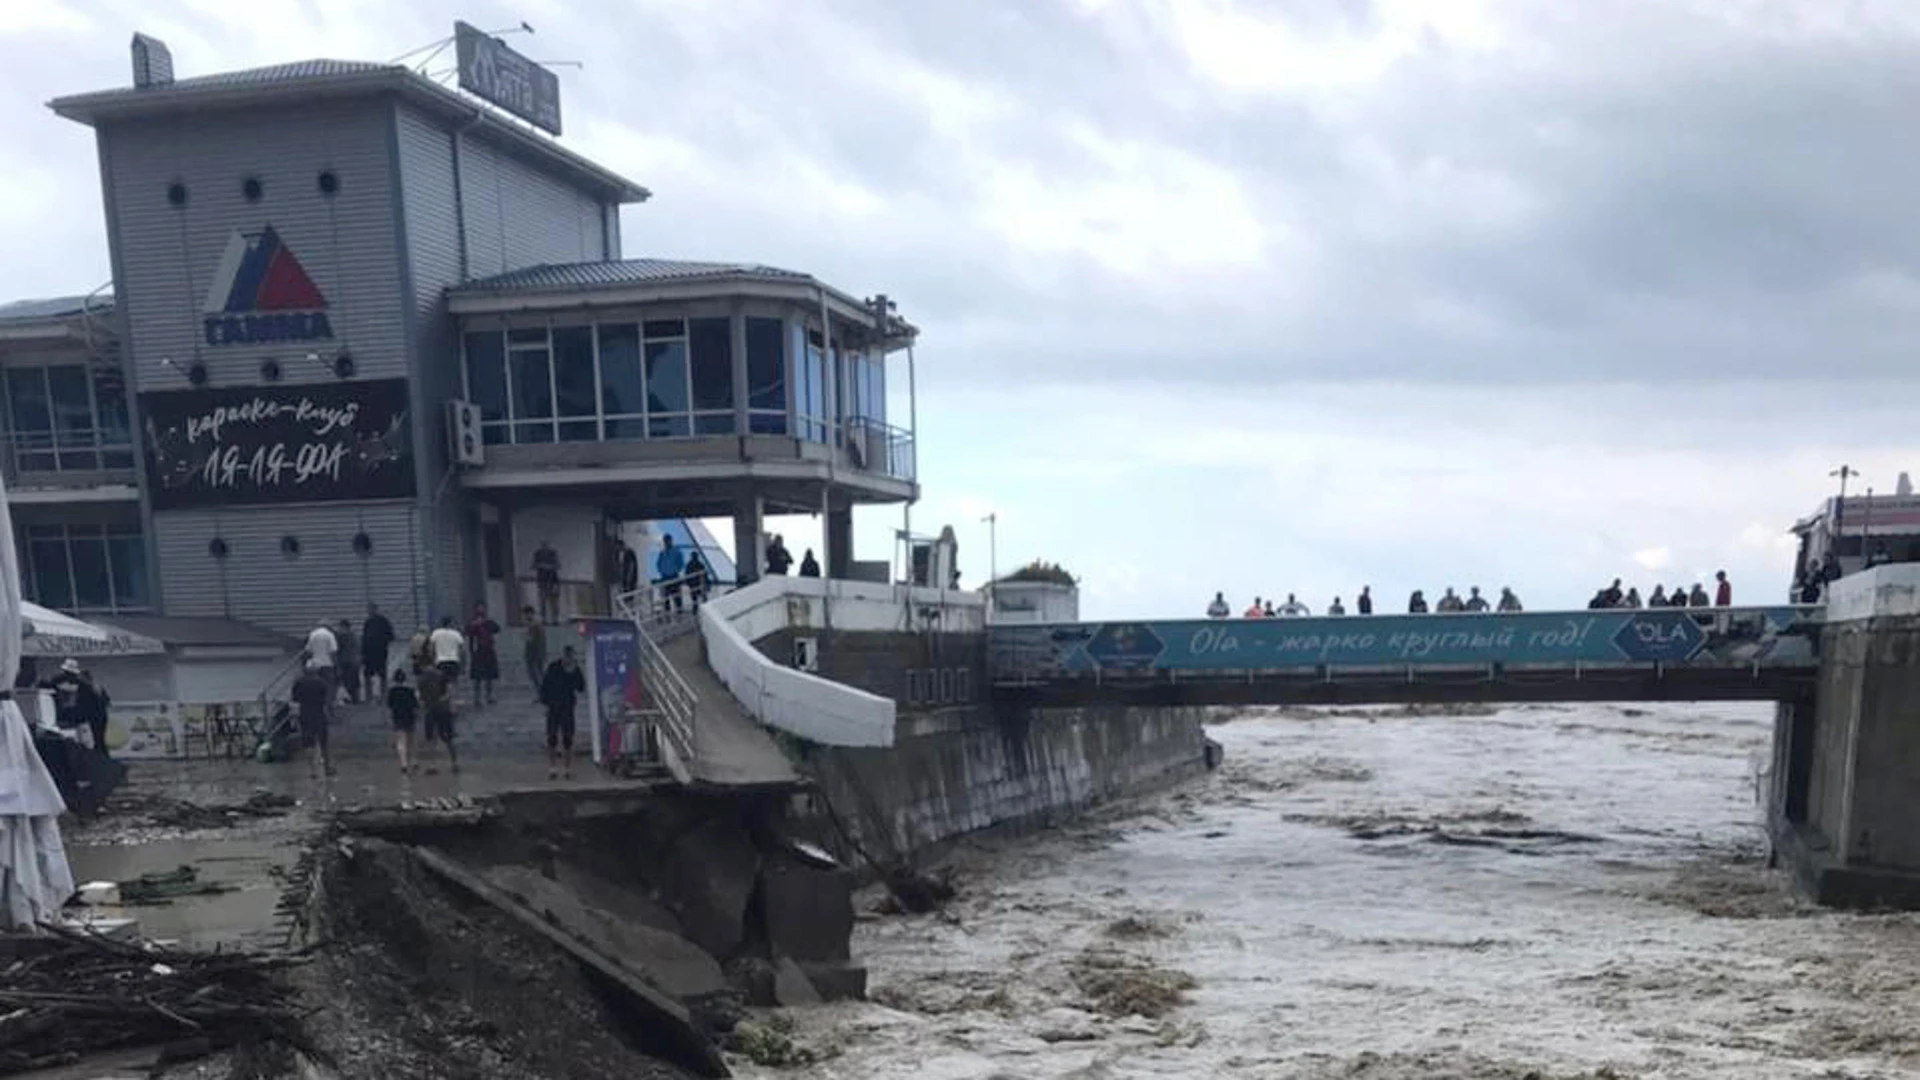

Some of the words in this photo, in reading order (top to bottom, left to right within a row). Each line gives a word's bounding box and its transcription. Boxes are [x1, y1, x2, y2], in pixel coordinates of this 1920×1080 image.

[1189, 625, 1240, 654] Ola
[1276, 632, 1377, 661] жарко
[1387, 627, 1517, 657] круглый
[1528, 617, 1596, 648] год!
[1635, 621, 1687, 642] OLA
